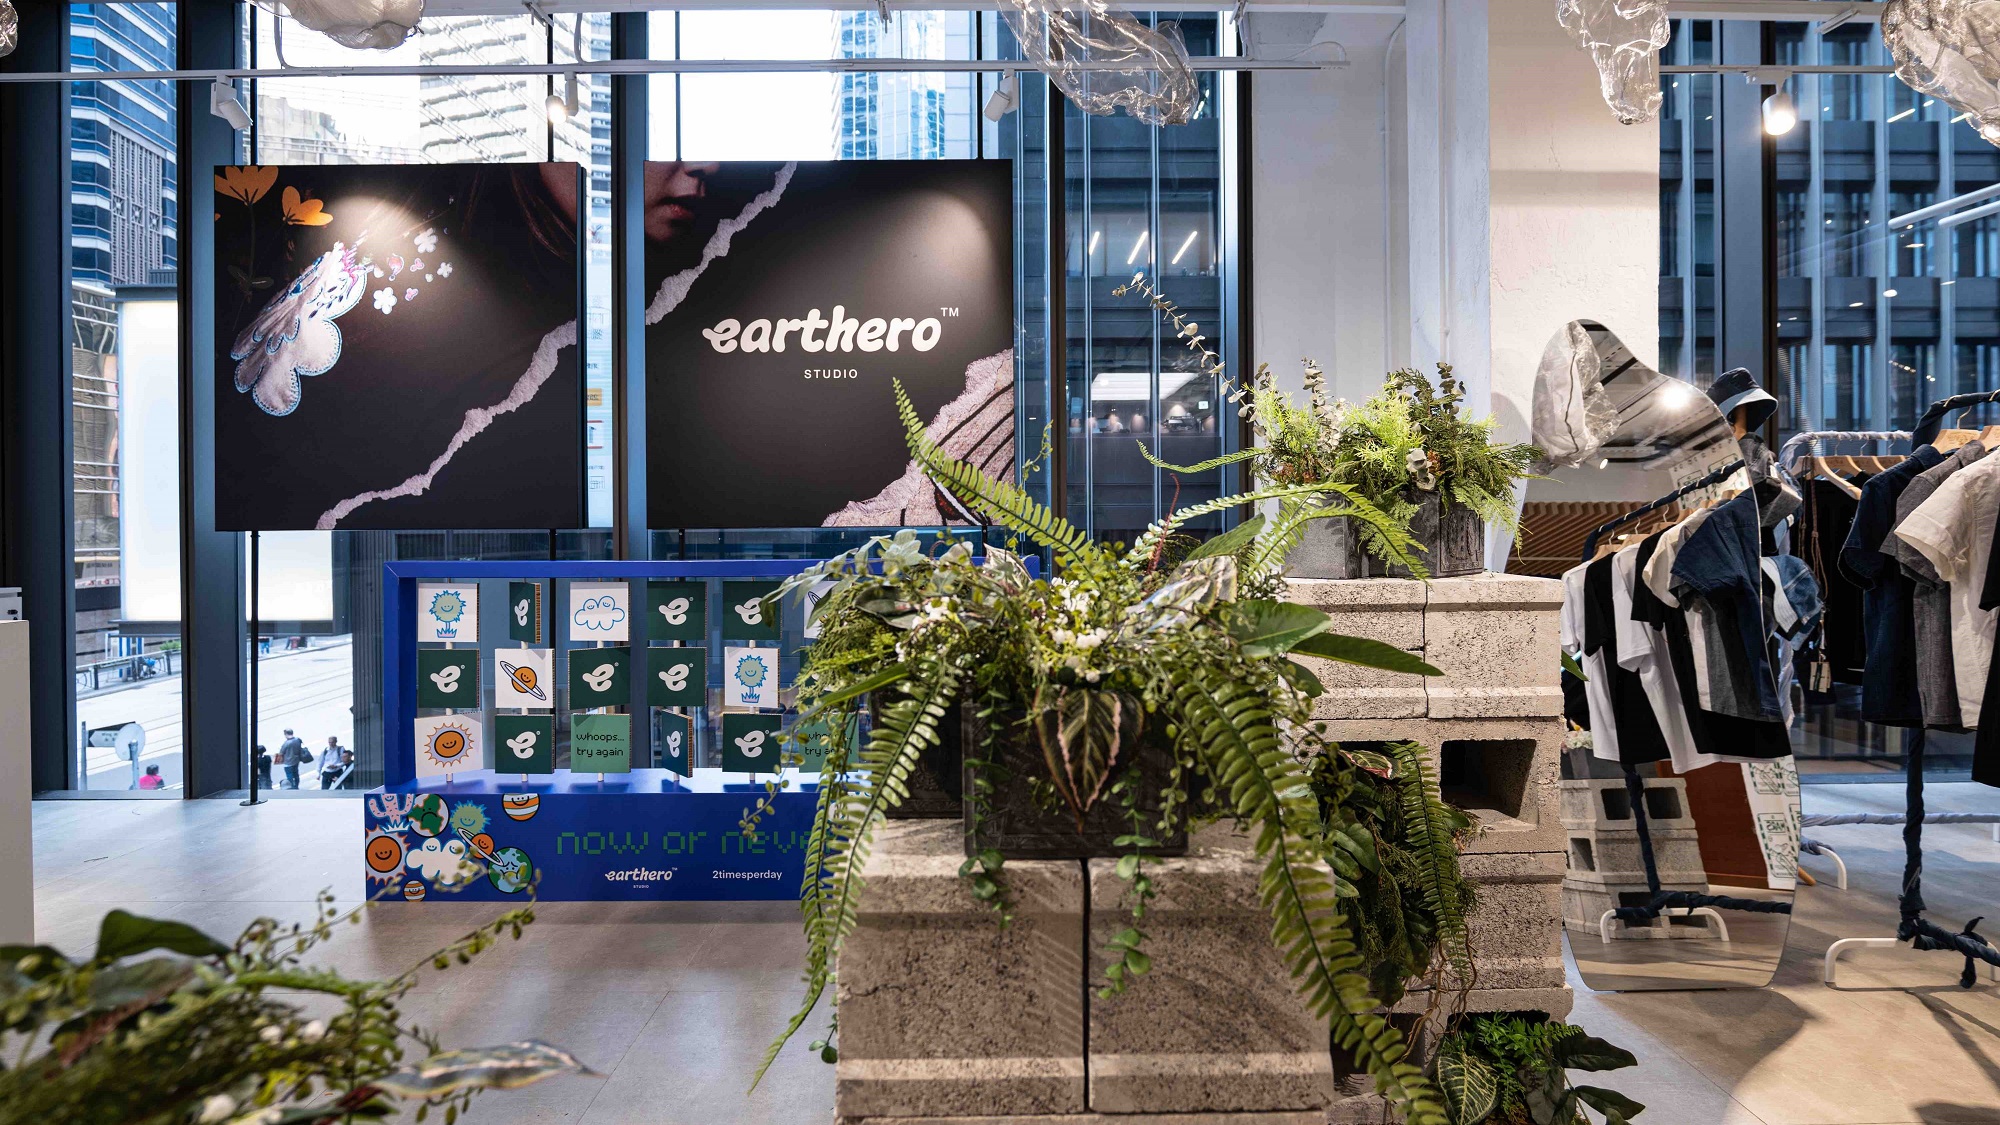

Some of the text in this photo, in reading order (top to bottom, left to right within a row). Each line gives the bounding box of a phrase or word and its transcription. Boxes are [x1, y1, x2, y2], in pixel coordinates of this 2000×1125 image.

[804, 368, 858, 379] STUDIO
[576, 732, 624, 743] whoops...
[576, 747, 624, 758] try again
[804, 747, 822, 757] try
[557, 831, 836, 855] now or neve
[712, 869, 783, 881] 2timesperday
